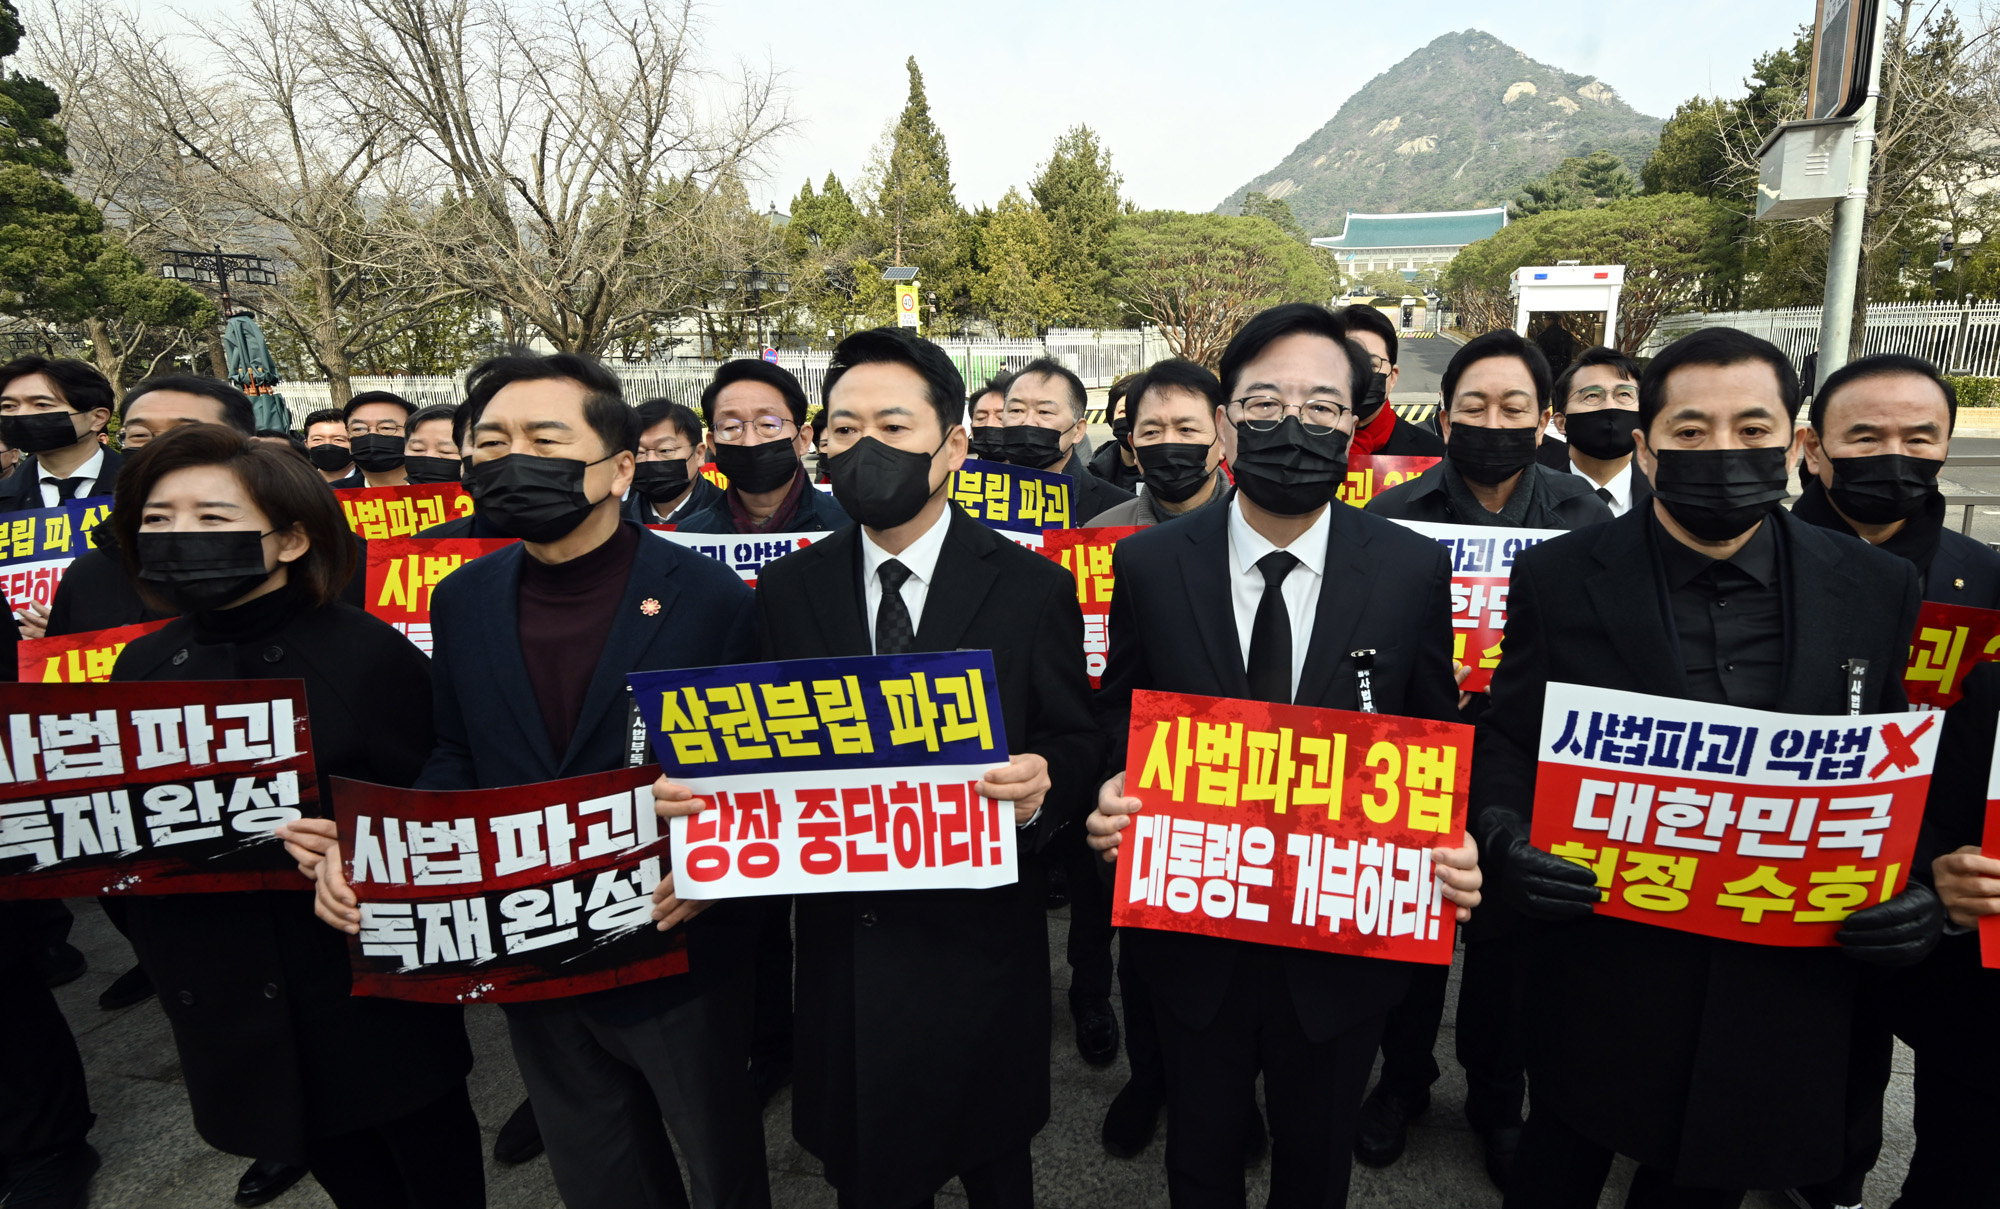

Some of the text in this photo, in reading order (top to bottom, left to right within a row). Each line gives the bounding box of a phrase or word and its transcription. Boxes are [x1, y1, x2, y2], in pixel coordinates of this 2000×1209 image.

[1018, 479, 1070, 529] 파괴
[0, 699, 297, 783] 사법 파괴
[660, 669, 994, 765] 삼권분립 파괴
[1551, 709, 1873, 781] 사법파괴 악법
[1138, 716, 1348, 821] 사법파괴
[0, 770, 302, 868] 독재 완성
[352, 784, 661, 886] 사법 파괴
[686, 780, 1003, 882] 당장 중단하라!
[1572, 778, 1894, 859] 대한민국
[358, 856, 662, 970] 독재 완성
[1129, 814, 1444, 940] 대통령은 거부하라!
